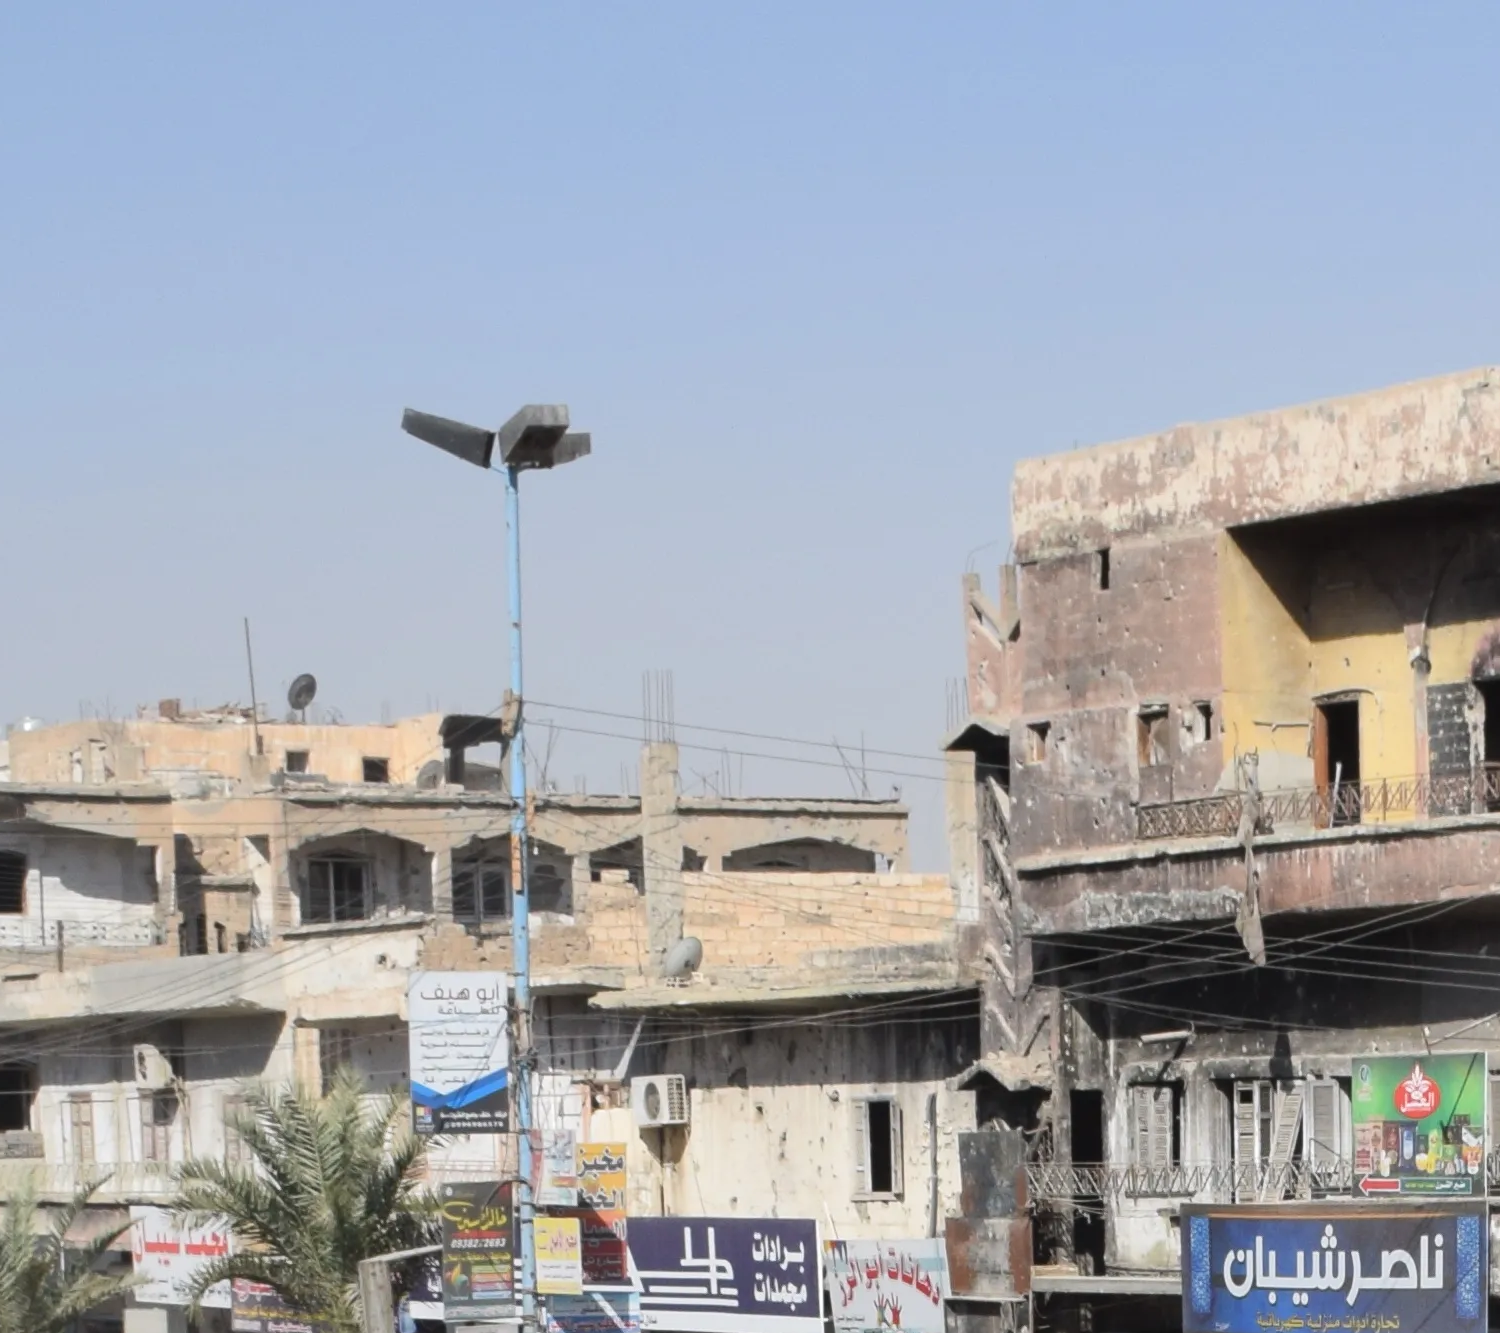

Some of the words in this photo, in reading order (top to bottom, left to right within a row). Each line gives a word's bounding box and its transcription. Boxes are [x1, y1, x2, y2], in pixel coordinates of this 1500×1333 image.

[476, 980, 500, 1004] أبو
[752, 1231, 805, 1273] برادات
[1223, 1223, 1347, 1305] شيبان
[1346, 1233, 1445, 1306] ناصر
[753, 1273, 808, 1311] مجمدات
[1306, 1313, 1341, 1333] منزلية
